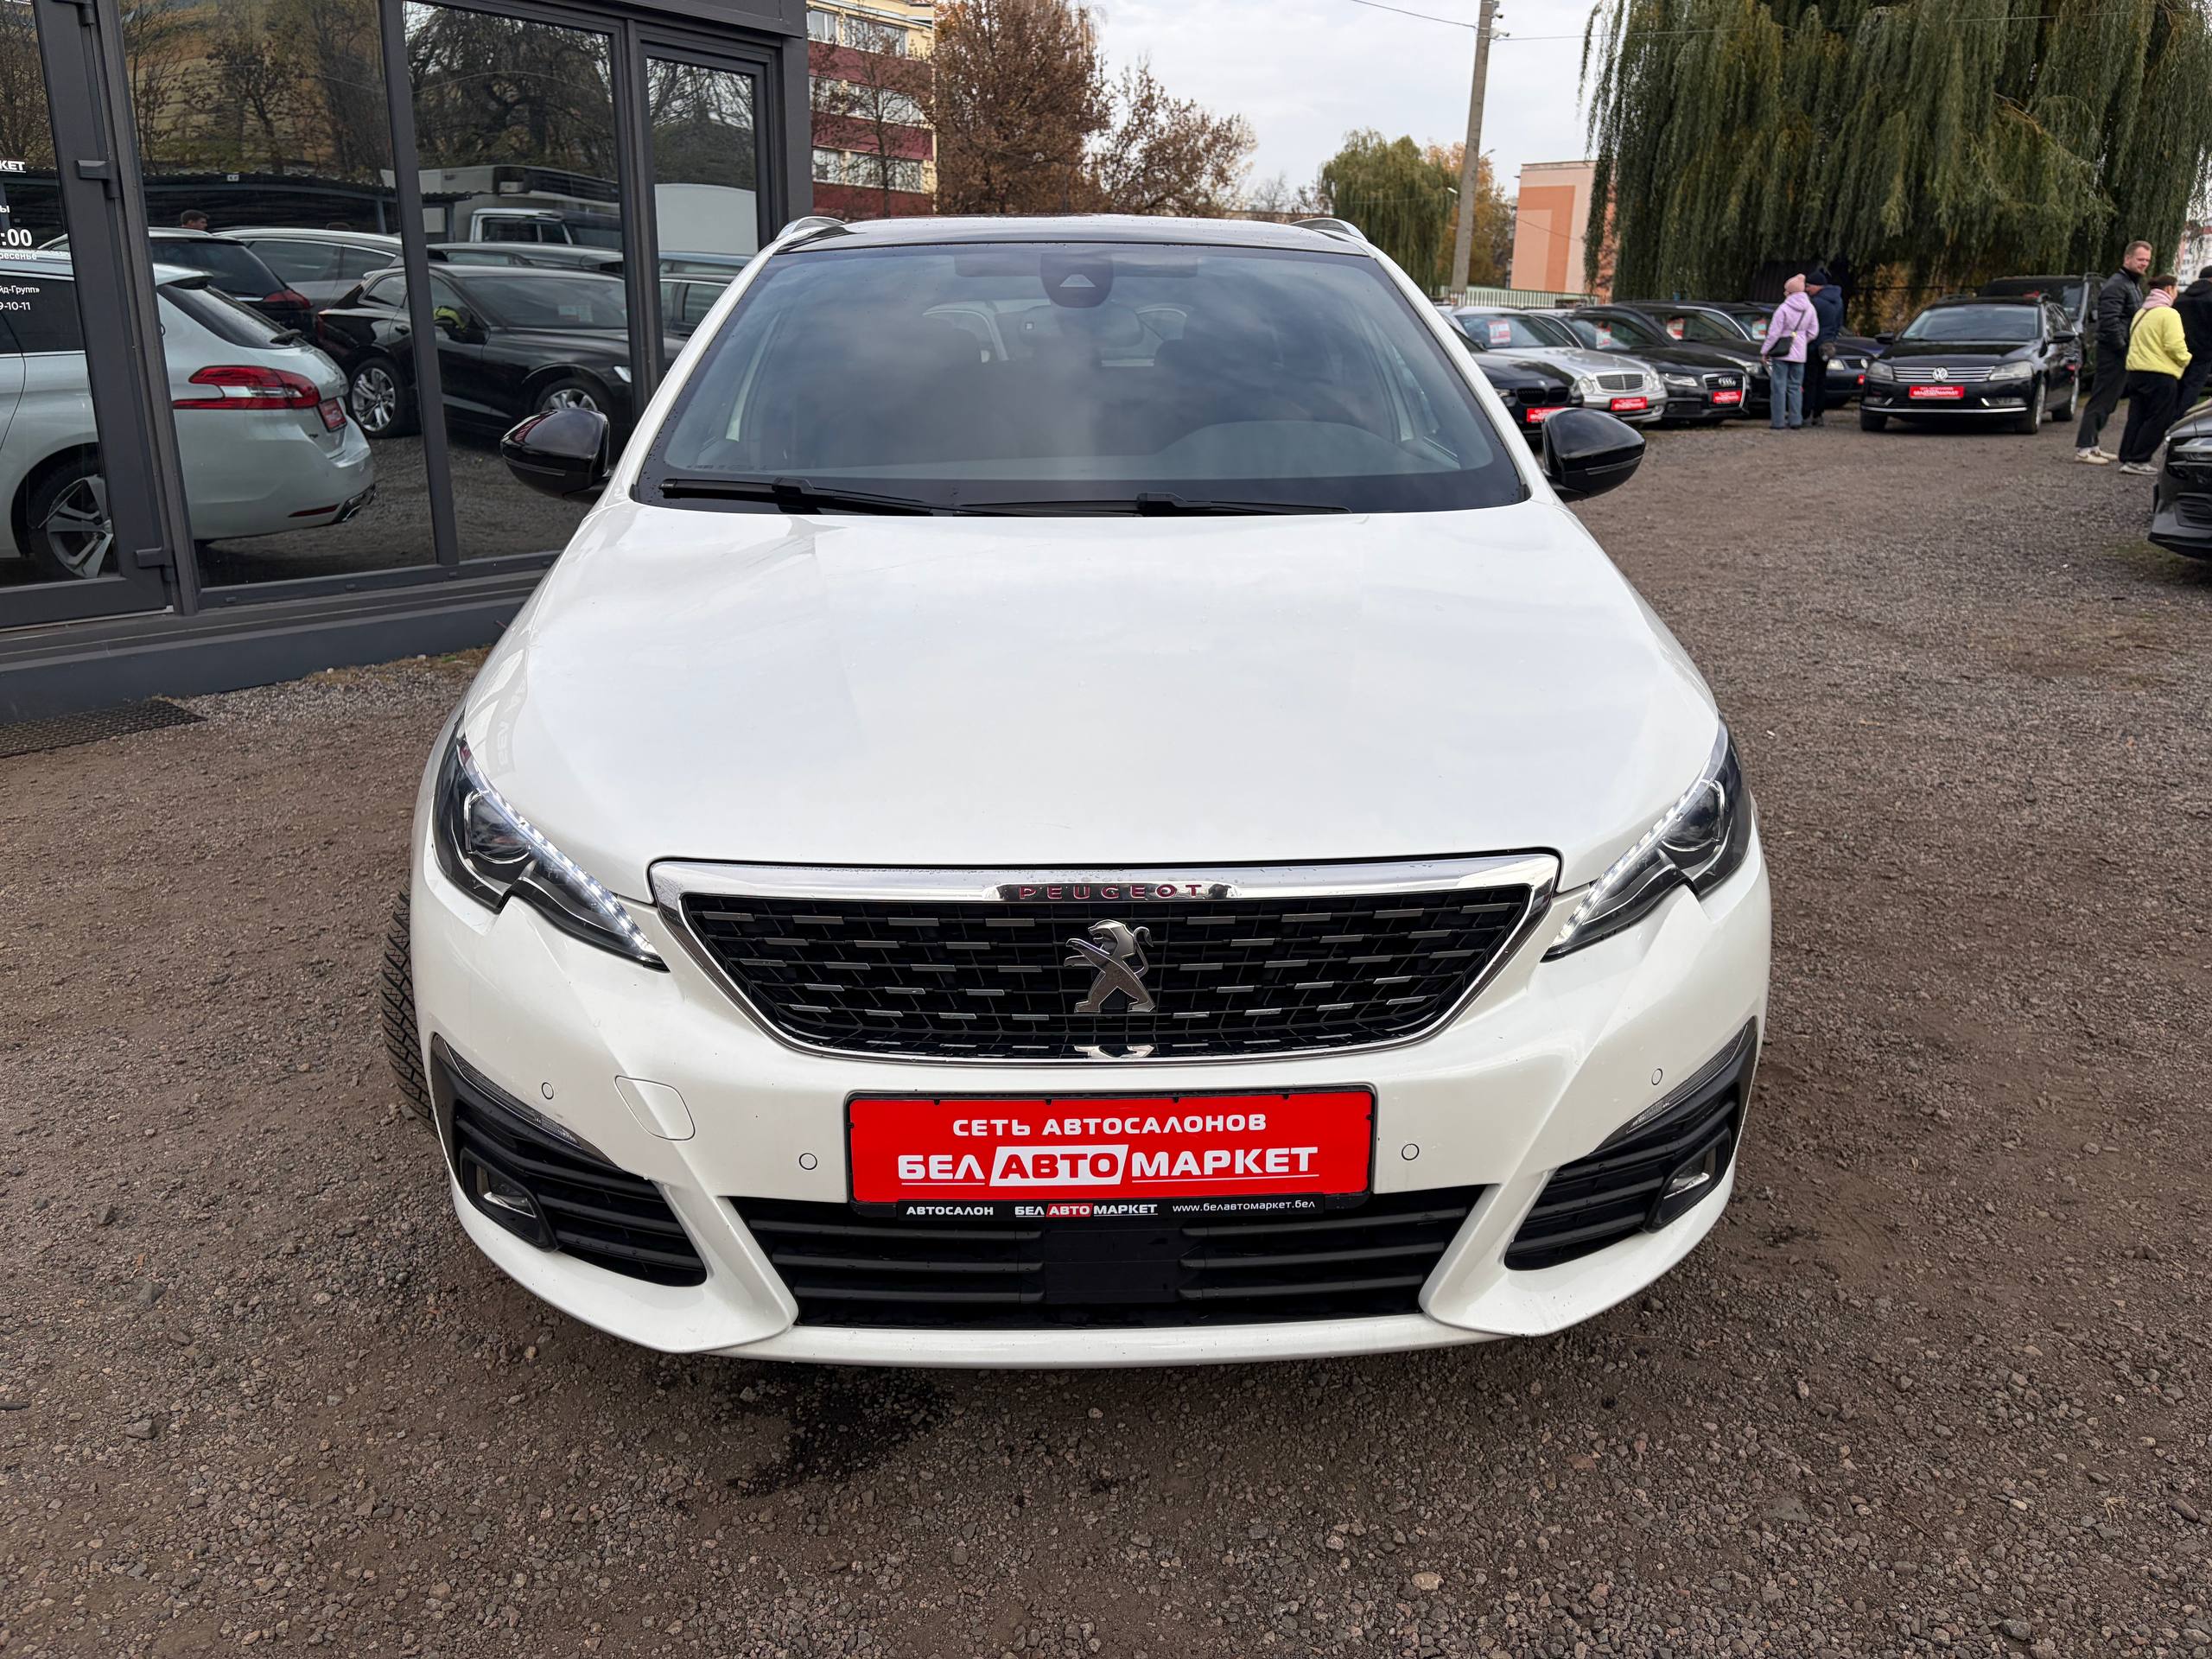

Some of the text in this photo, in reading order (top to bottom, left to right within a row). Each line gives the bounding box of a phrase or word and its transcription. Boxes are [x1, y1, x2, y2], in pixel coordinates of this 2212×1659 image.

[1019, 884, 1202, 899] PEUGEOT
[953, 1114, 1267, 1136] СЕТЬ АВТОСАЛОНОВ
[906, 1205, 994, 1216] АВТОСАЛОН
[1173, 1199, 1316, 1212] www.белавтомаркет.бел
